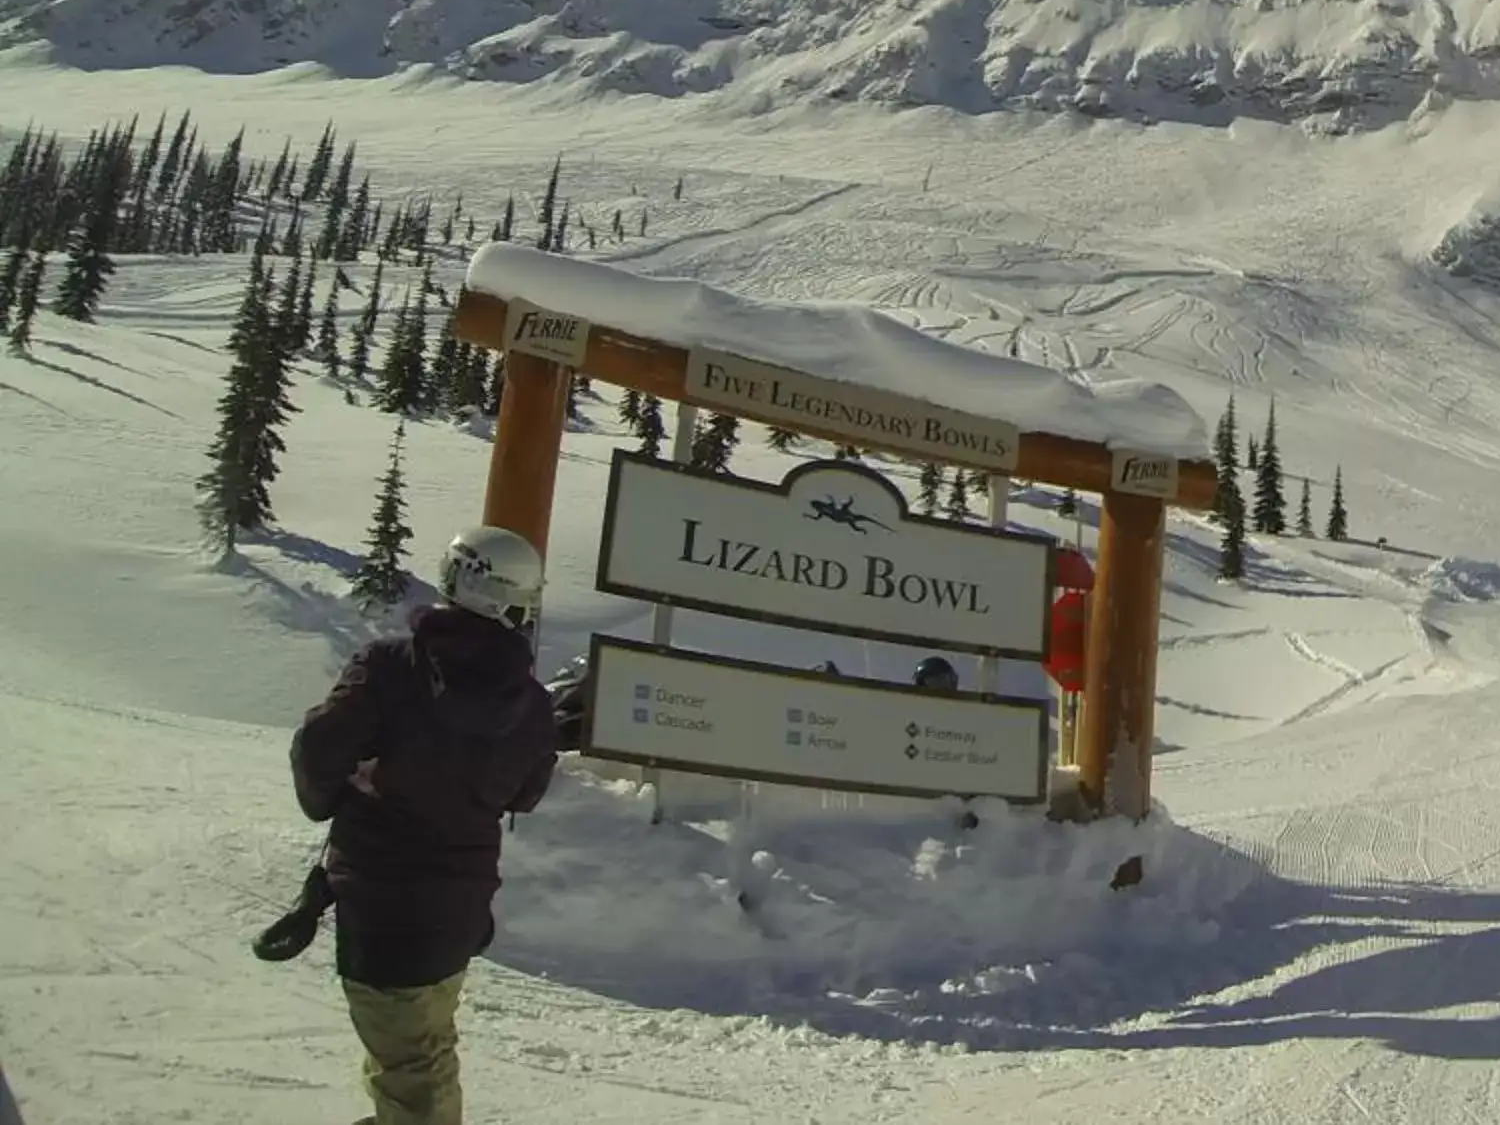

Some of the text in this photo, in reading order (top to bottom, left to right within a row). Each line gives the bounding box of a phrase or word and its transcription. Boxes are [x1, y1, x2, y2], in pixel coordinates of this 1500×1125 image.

[703, 362, 1007, 458] FIVE LEGENDARY BOWLS
[678, 518, 991, 615] LIZARD BOWL
